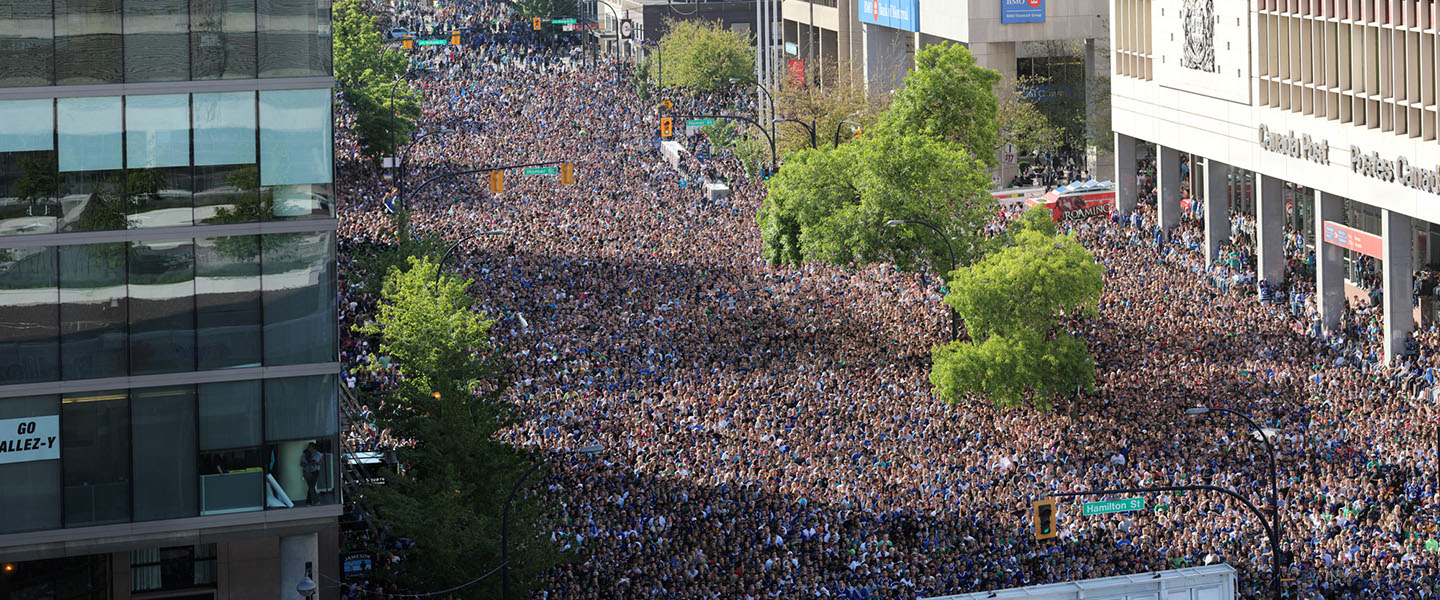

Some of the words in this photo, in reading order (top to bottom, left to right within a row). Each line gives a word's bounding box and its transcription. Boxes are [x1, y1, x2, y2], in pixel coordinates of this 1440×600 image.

[1259, 123, 1301, 158] Canada
[1302, 132, 1328, 164] Post
[1350, 145, 1394, 182] Postes
[1064, 203, 1110, 221] ROAMING
[17, 421, 36, 435] GO
[0, 436, 56, 453] ALLEZ-Y
[1087, 503, 1127, 513] Hamilton
[1130, 500, 1140, 509] St
